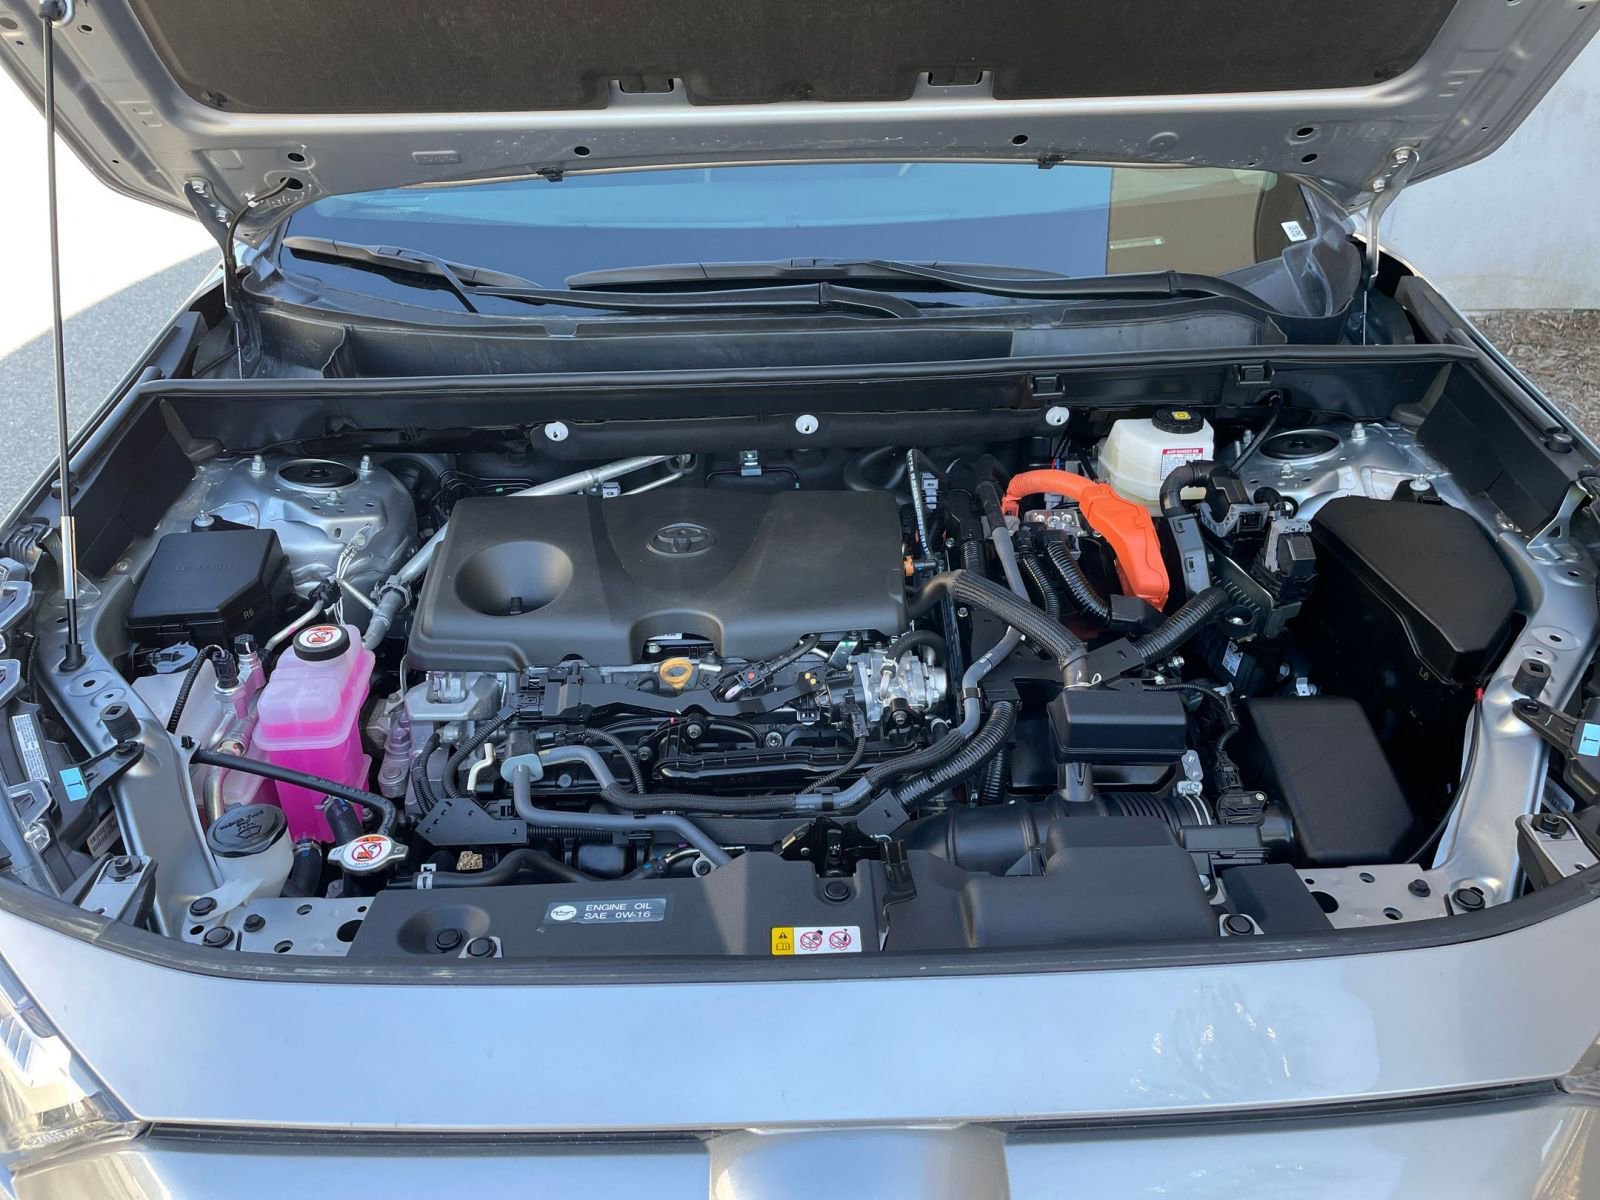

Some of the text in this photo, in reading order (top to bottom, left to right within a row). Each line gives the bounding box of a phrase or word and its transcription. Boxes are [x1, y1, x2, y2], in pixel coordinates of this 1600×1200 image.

[585, 902, 653, 912] ENGINE OIL
[583, 911, 651, 920] SAE 0W-16
